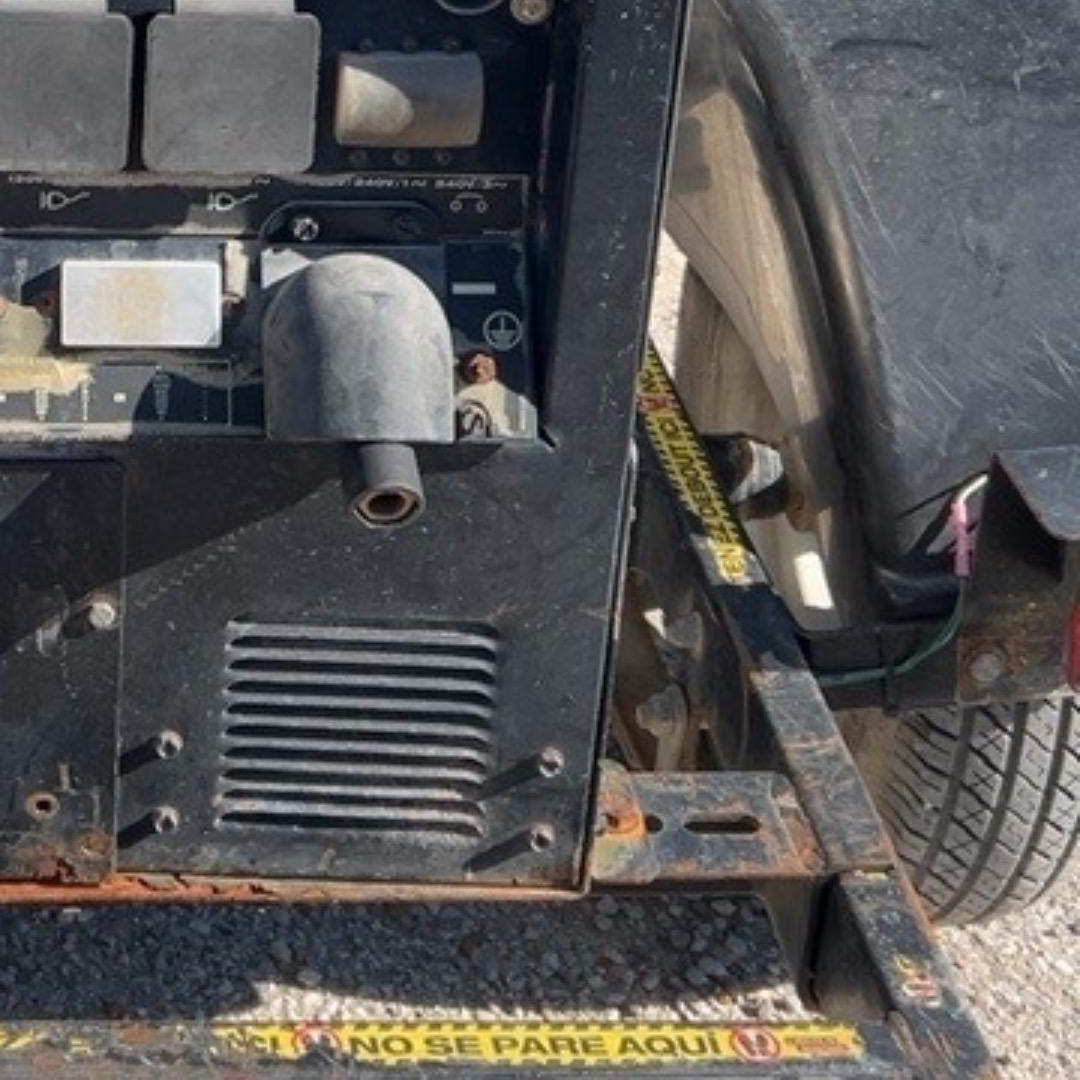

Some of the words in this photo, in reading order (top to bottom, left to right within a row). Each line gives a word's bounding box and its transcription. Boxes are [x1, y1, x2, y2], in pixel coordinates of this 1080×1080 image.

[350, 1035, 412, 1055] NO
[424, 1035, 481, 1056] SE
[491, 1035, 602, 1057] PARE
